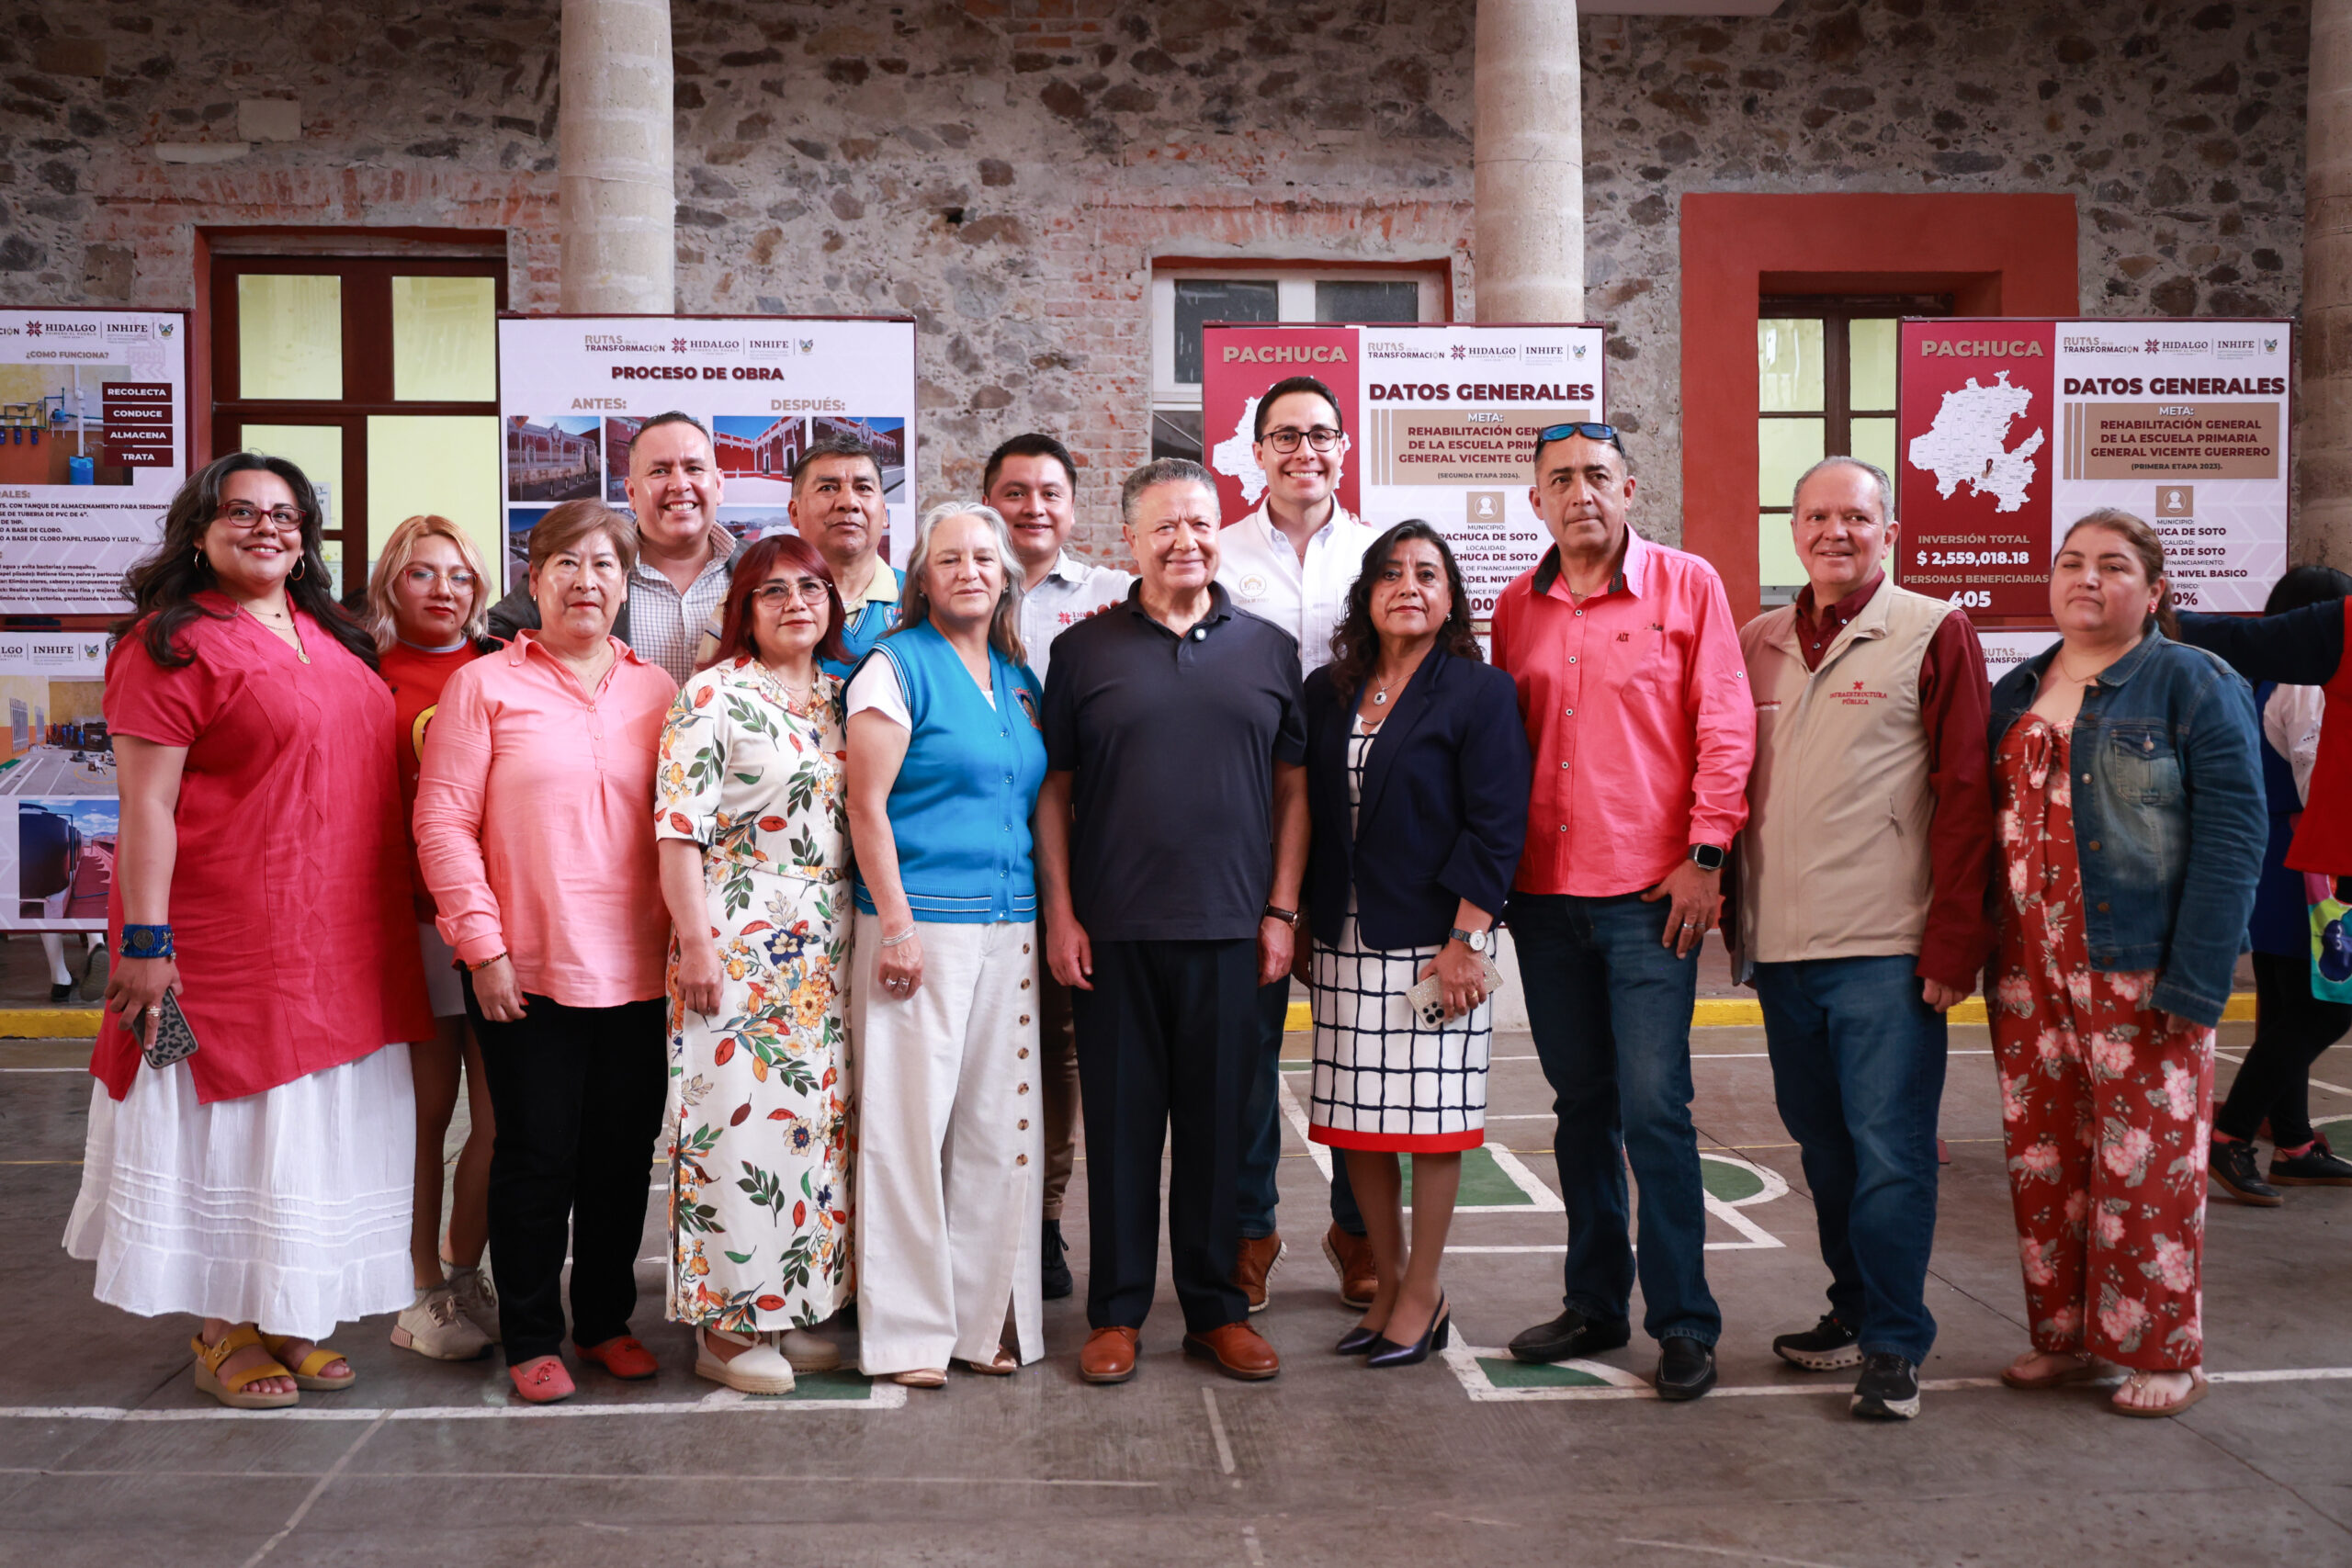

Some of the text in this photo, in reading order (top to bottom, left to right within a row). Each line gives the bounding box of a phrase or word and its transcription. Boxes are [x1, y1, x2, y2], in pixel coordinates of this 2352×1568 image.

[585, 335, 623, 344] RUTAS
[2064, 337, 2099, 346] RUTAS
[585, 344, 665, 352] TRANSFORMACIÓN
[1368, 343, 1404, 351] RUTAS
[1922, 340, 2044, 357] PACHUCA
[1223, 346, 1348, 362] PACHUCA
[612, 366, 784, 380] PROCESO DE OBRA
[2064, 378, 2285, 394] DATOS GENERALES
[1369, 384, 1595, 401] DATOS GENERALES
[571, 398, 627, 409] ANTES:
[771, 397, 845, 411] DESPUÉS:
[2159, 407, 2194, 415] META:
[1468, 413, 1504, 423] META:
[2100, 419, 2261, 429] REHABILITACIÓN GENERAL
[1408, 425, 1512, 436] REHABILITACIÓN
[2101, 434, 2257, 443] DE LA ESCUELA PRIMARIA
[1408, 440, 1537, 449] DE LA ESCUELA PRIM
[2091, 448, 2270, 457] GENERAL VICENTE GUERRERO
[1399, 454, 1456, 463] GENERAL
[1459, 454, 1511, 463] VICENTE
[1918, 534, 2030, 544] INVERSIÓN TOTAL
[1917, 550, 2029, 567] $ 2,559,018.18
[1903, 575, 2049, 584] PERSONAS BENEFICIARIAS
[1949, 590, 1991, 607] 405
[2172, 592, 2198, 606] 0%
[1471, 598, 1494, 611] 00
[1982, 648, 2016, 656] RUTAS
